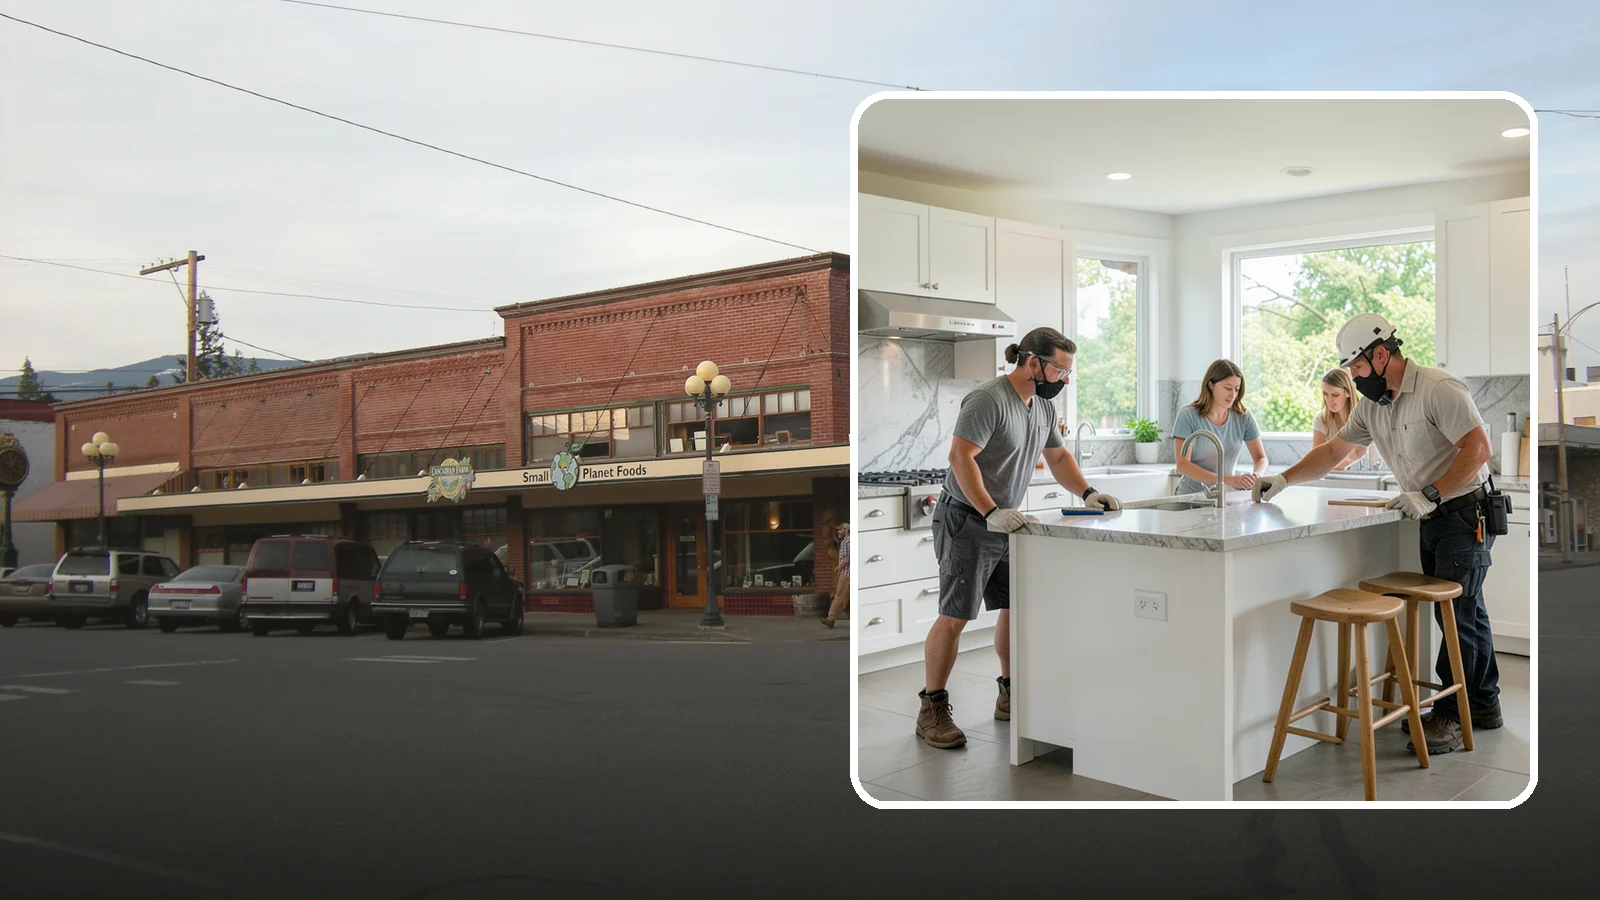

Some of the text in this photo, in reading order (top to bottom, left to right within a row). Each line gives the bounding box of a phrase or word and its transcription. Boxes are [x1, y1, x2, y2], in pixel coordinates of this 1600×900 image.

[523, 464, 647, 482] Small Planet Foods
